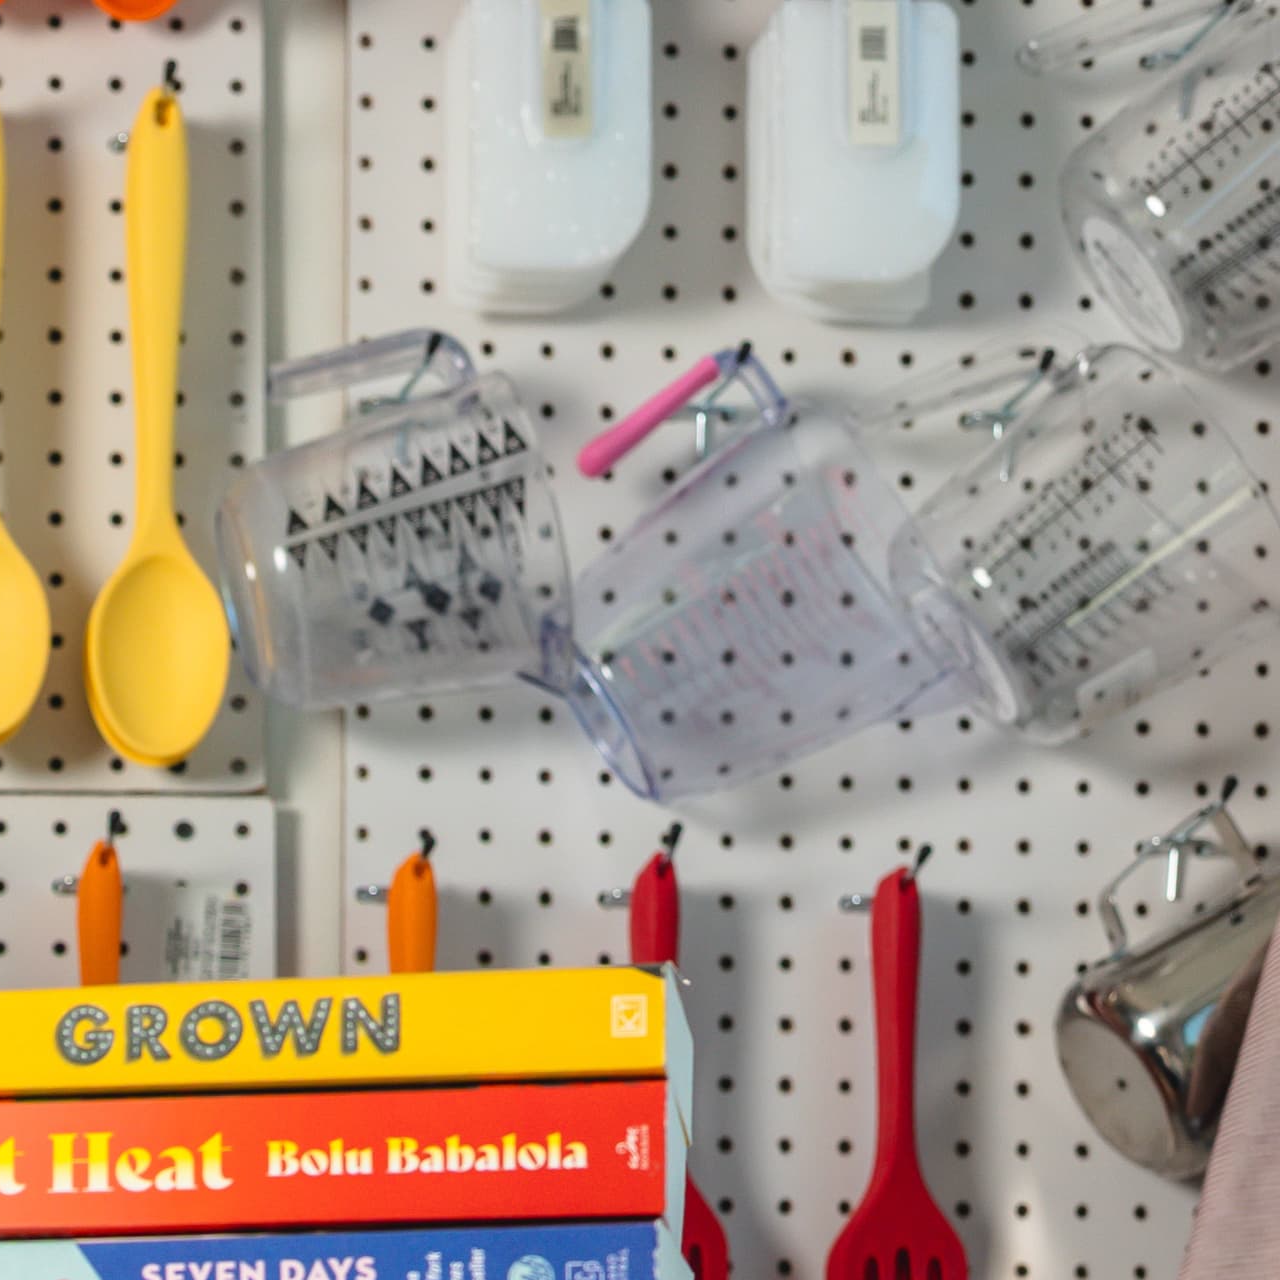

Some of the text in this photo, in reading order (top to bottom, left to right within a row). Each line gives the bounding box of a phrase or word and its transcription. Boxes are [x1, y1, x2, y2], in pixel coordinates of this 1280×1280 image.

[55, 993, 401, 1066] GROWN
[48, 1131, 235, 1195] Heat
[267, 1139, 374, 1178] Bolu
[386, 1133, 589, 1176] Babalola
